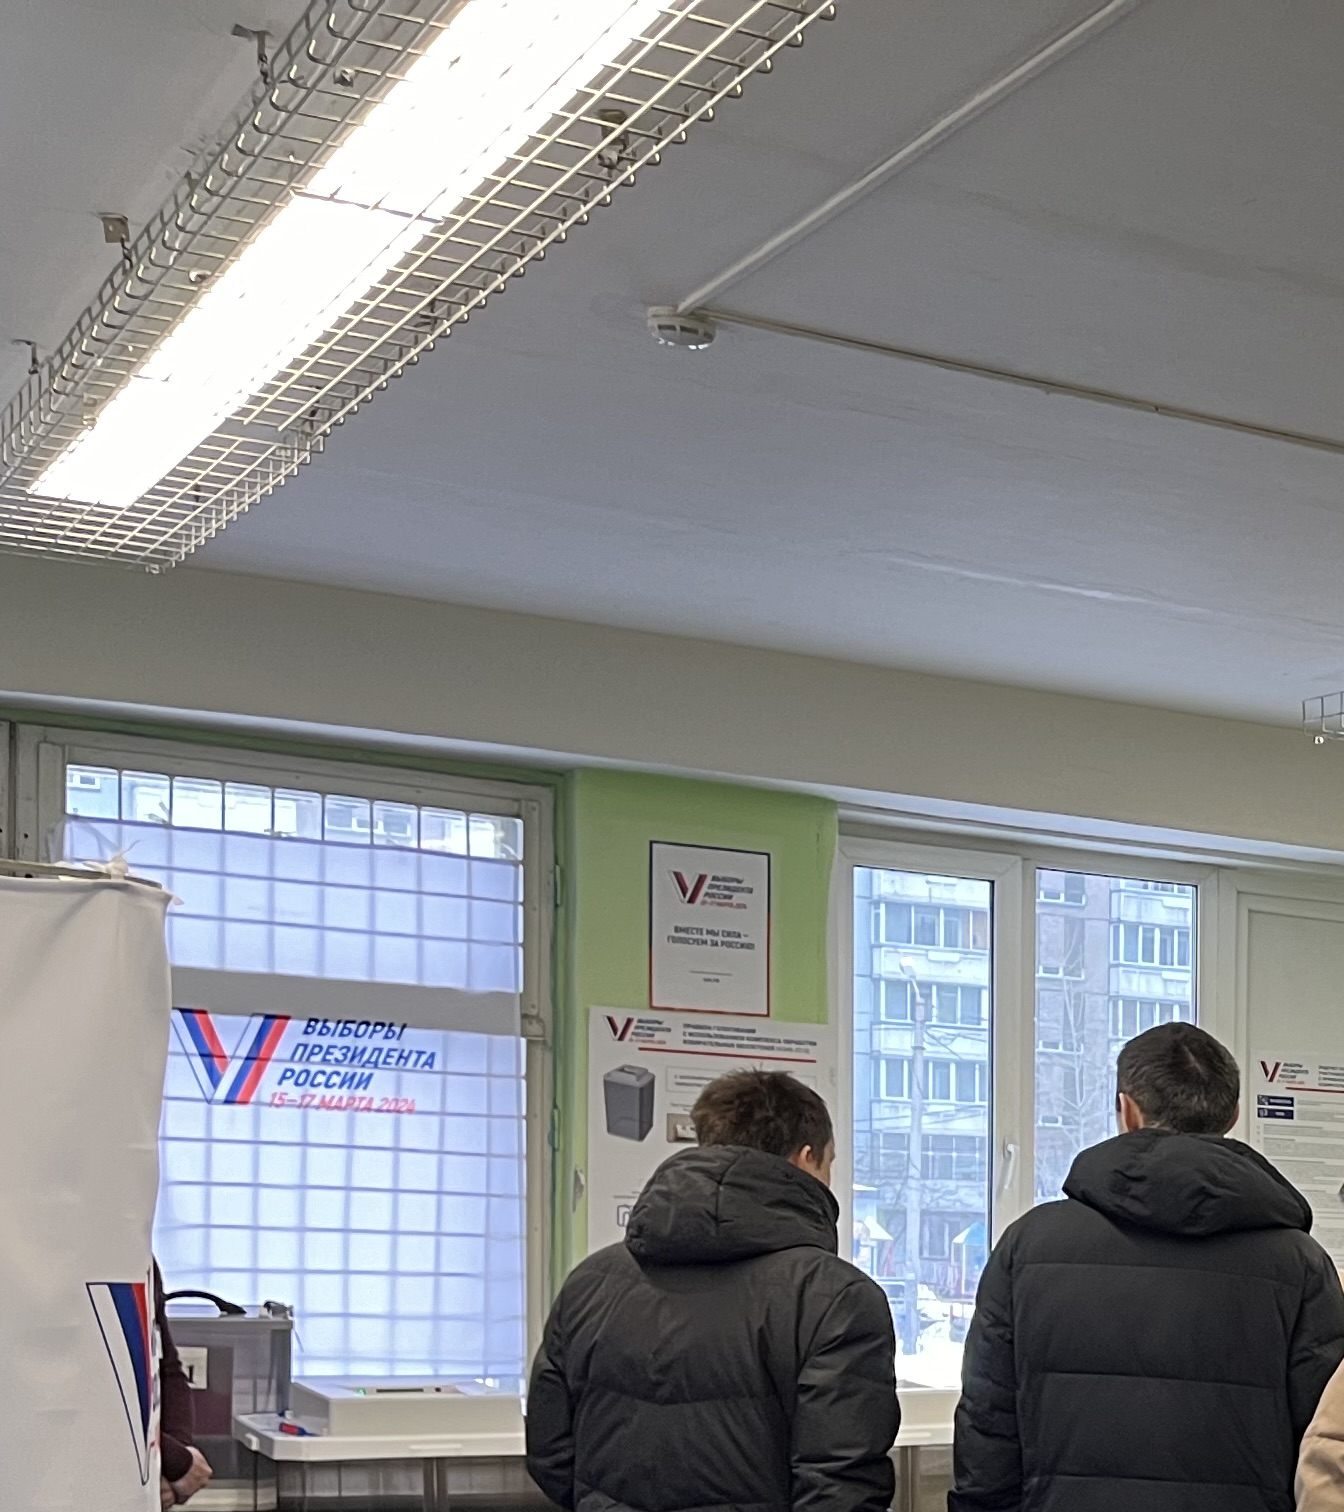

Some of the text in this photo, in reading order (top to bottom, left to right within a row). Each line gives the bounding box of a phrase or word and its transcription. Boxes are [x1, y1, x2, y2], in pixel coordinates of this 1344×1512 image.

[302, 1017, 407, 1041] ВЫБОРЫ
[290, 1042, 437, 1070] ПРЕЗИДЕНТА
[277, 1067, 374, 1091] РОССИИ
[318, 1094, 374, 1111] МАРТА
[376, 1096, 416, 1114] 2024
